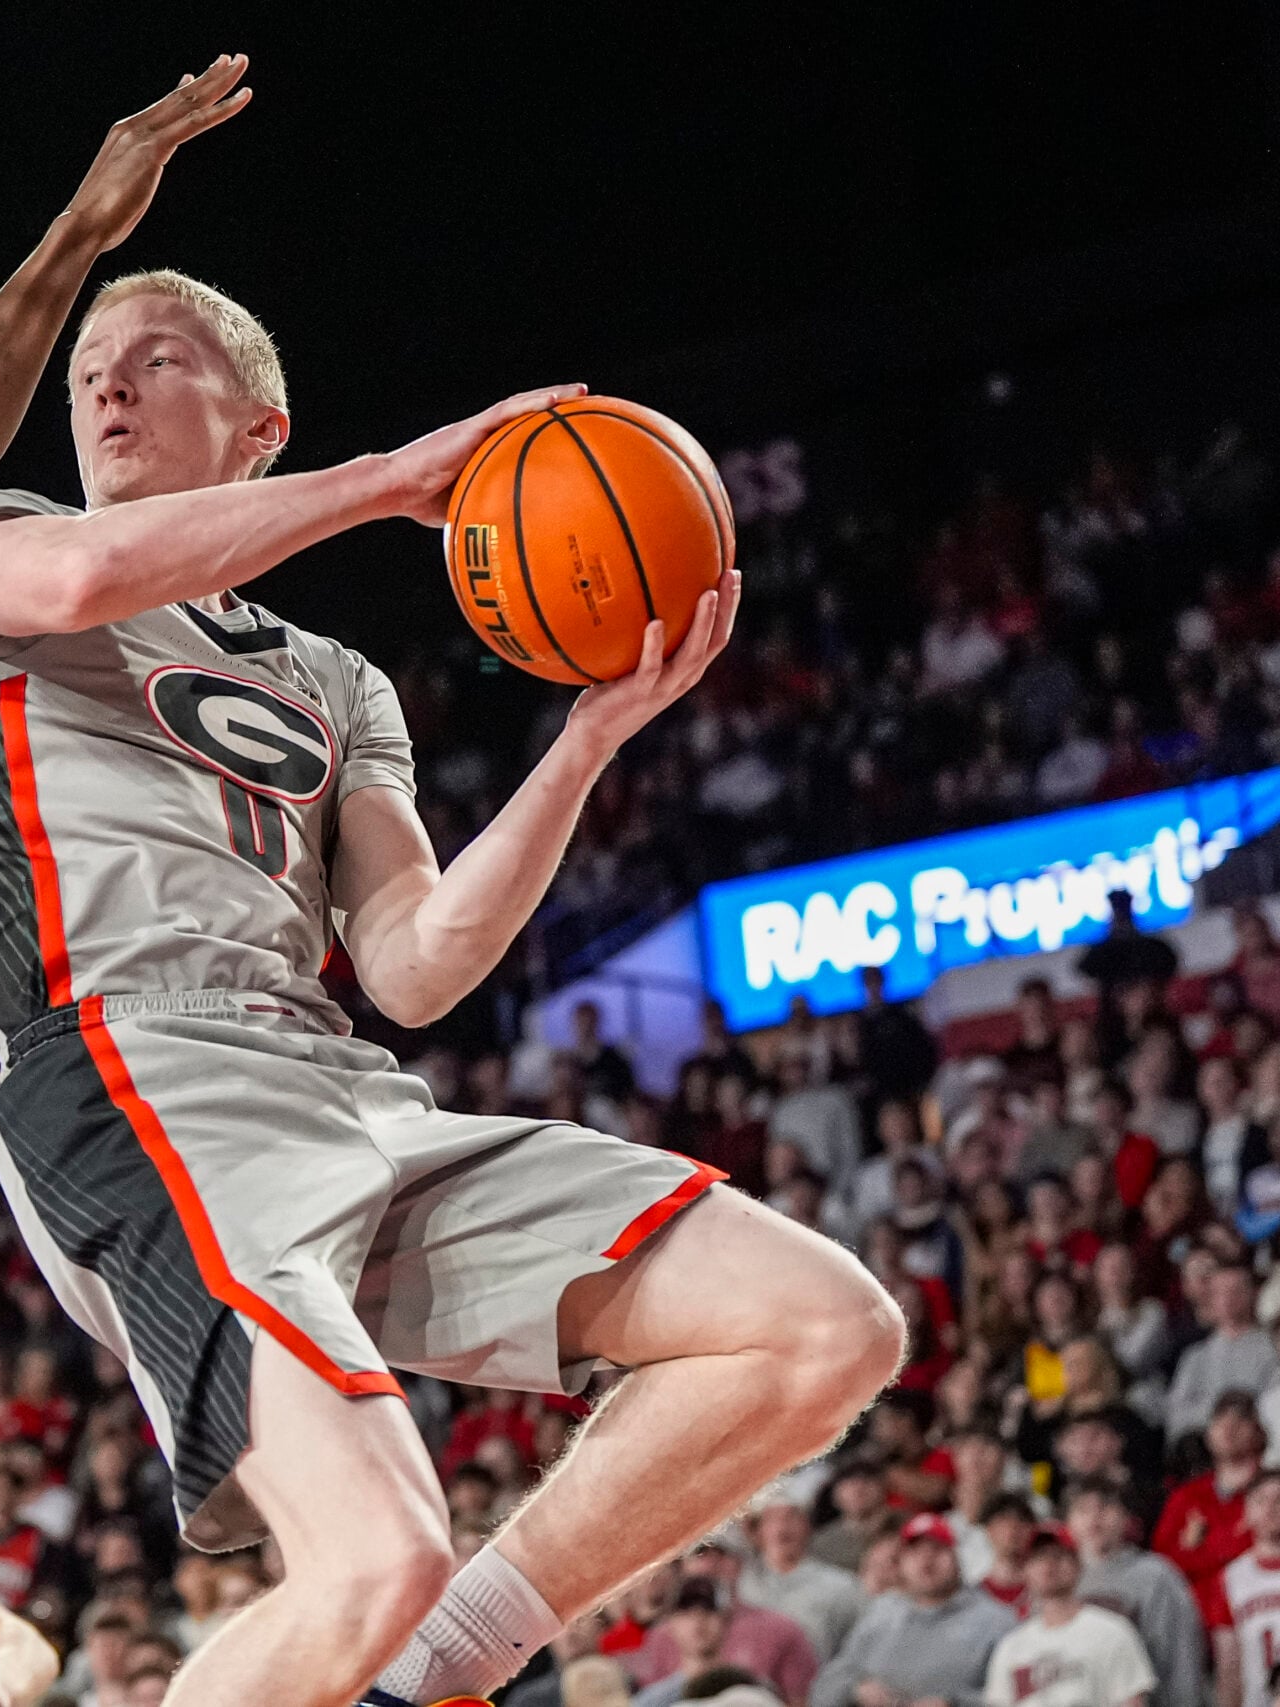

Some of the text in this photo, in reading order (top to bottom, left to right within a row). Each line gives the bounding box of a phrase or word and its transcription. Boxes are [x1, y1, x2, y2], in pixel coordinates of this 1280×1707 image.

[464, 525, 535, 661] ELITE
[144, 665, 335, 805] G
[741, 881, 902, 990] RAC
